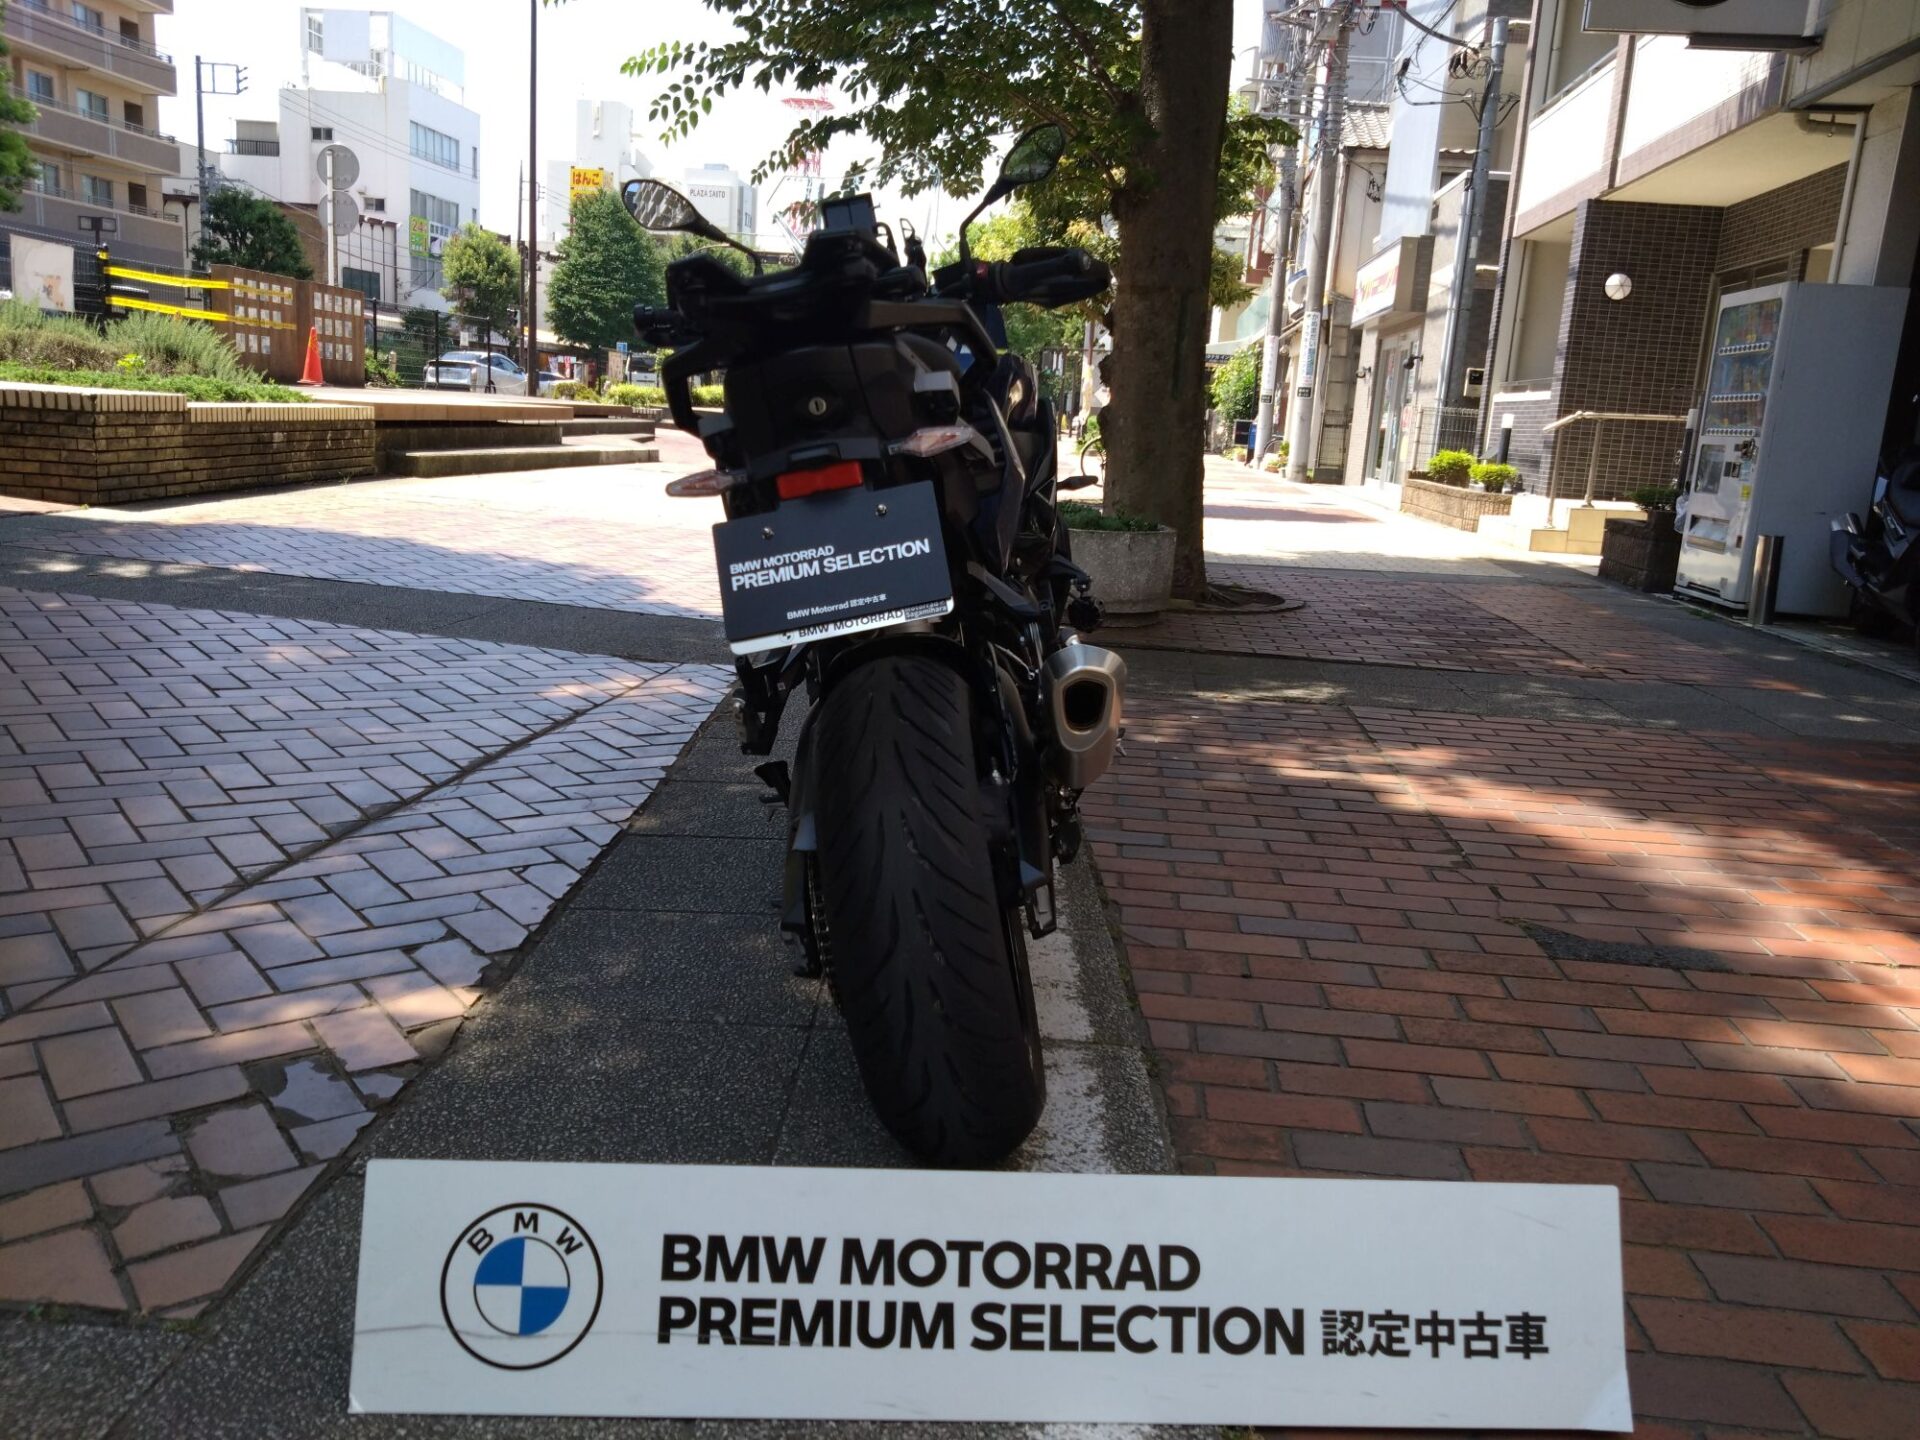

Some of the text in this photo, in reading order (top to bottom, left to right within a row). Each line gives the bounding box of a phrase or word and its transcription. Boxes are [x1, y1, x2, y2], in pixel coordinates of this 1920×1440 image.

[572, 171, 600, 185] はんこ
[689, 188, 708, 198] PLAZA
[729, 545, 835, 575] BMW MOTORRAD
[731, 538, 930, 592] PREMIUM SELECTION
[786, 608, 811, 620] BMW
[811, 600, 849, 616] Motorrad
[799, 608, 903, 638] BMW MOTORRAD
[905, 605, 947, 619] Sagamihara
[466, 1211, 584, 1256] BMW
[661, 1233, 1201, 1292] BMW MOTORRAD
[657, 1296, 1549, 1360] PREMIUM SELECTION 認定中古車
